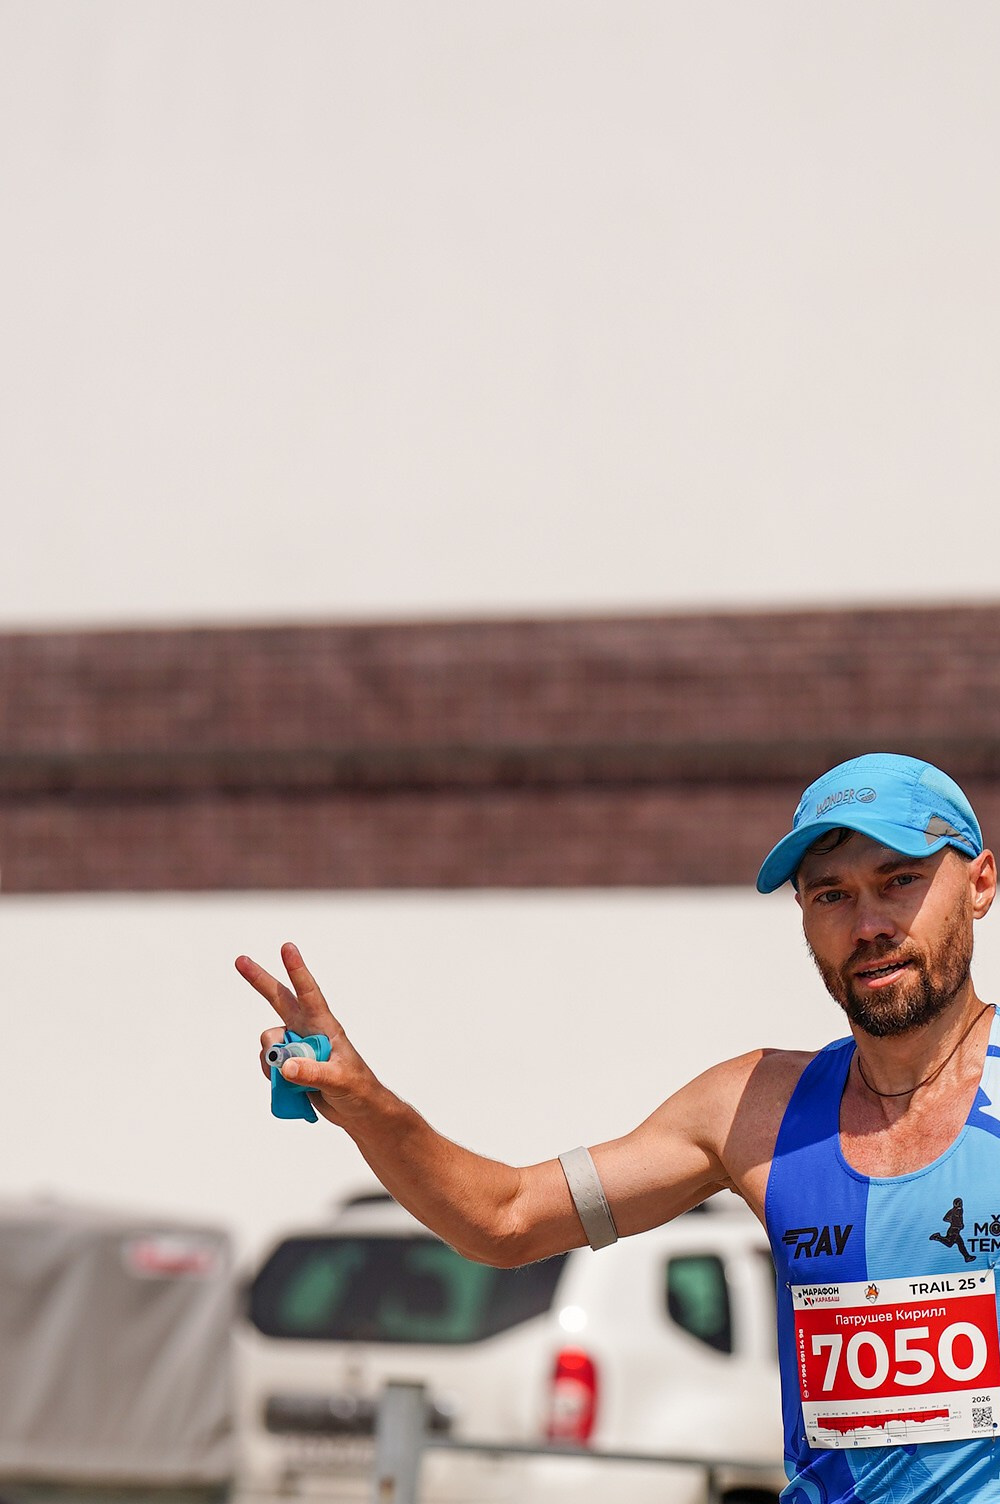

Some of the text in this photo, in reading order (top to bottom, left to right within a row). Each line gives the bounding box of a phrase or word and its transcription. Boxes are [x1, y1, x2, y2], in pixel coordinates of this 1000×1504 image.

[782, 1225, 853, 1259] RAY
[802, 1287, 839, 1296] МАРАФОН
[909, 1278, 976, 1295] TRAIL 25
[835, 1308, 946, 1326] Патрушев Кирилл
[811, 1322, 988, 1391] 7050
[971, 1395, 991, 1404] 2026
